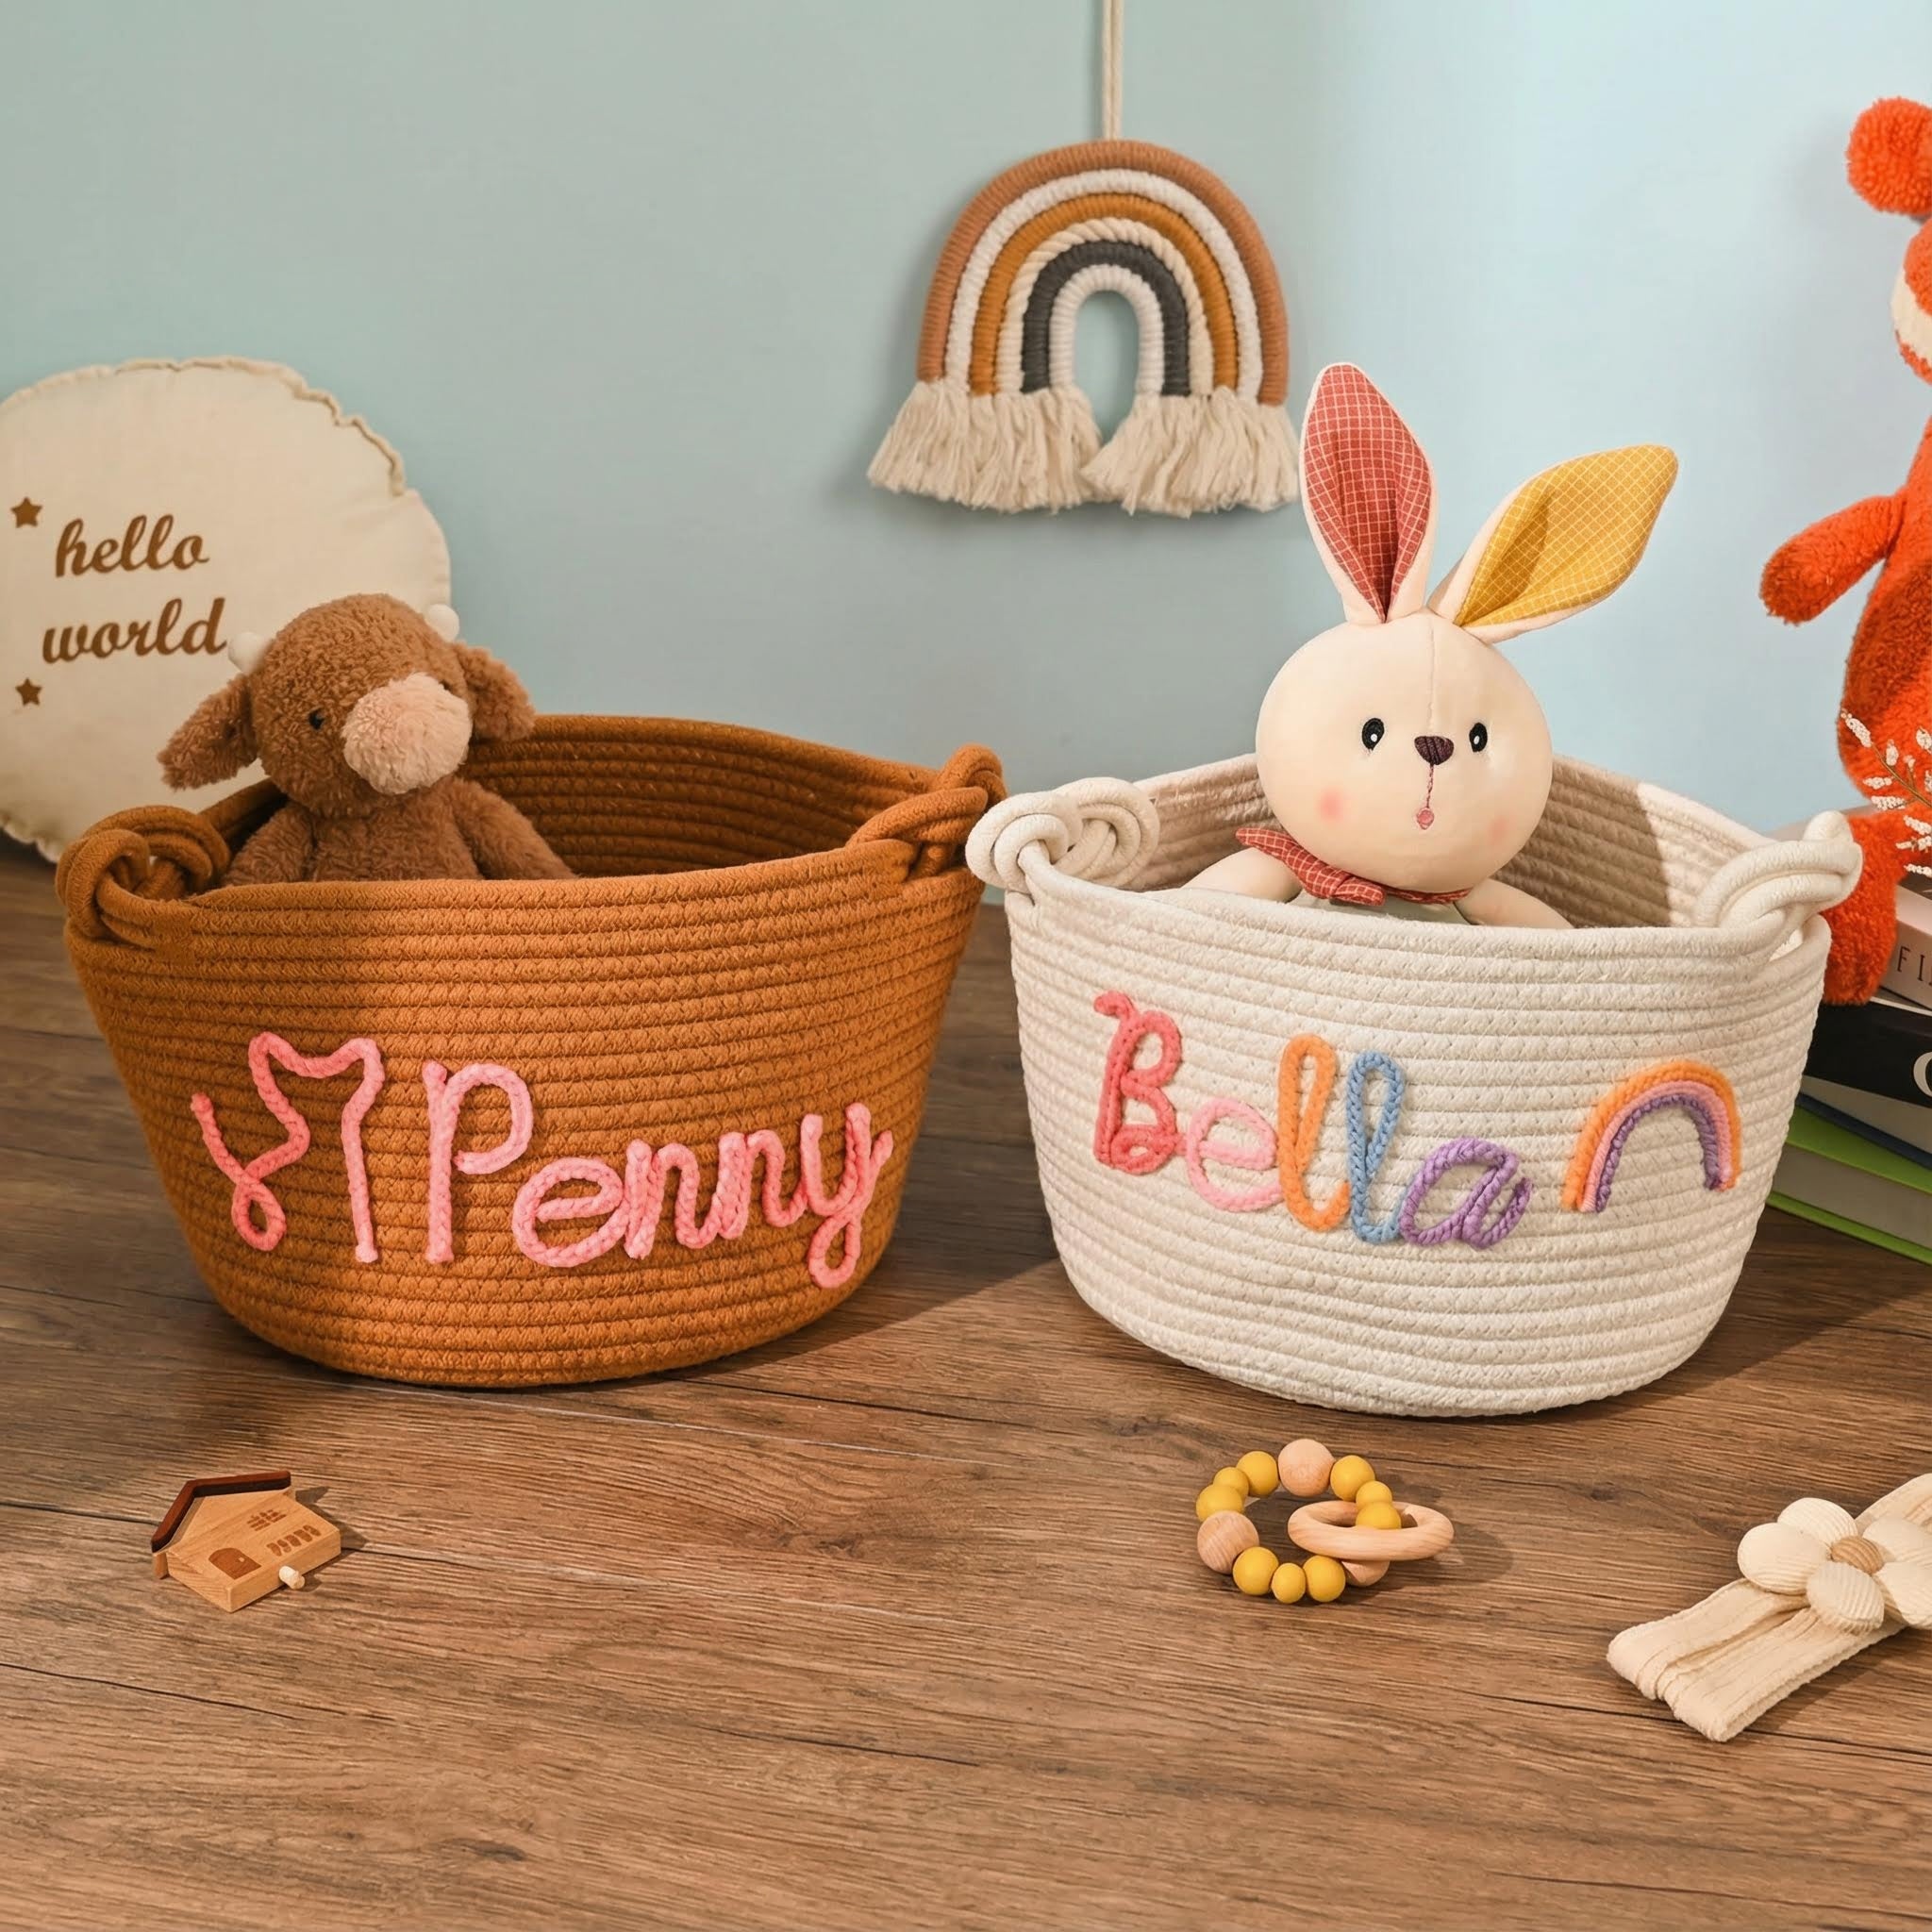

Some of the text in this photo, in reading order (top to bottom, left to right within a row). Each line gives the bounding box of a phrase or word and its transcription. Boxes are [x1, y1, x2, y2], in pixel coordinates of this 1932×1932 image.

[55, 514, 210, 578] hello
[42, 597, 227, 664] world
[1897, 945, 1932, 987] FI
[1093, 991, 1532, 1250] Bella
[422, 1060, 892, 1289] Penny
